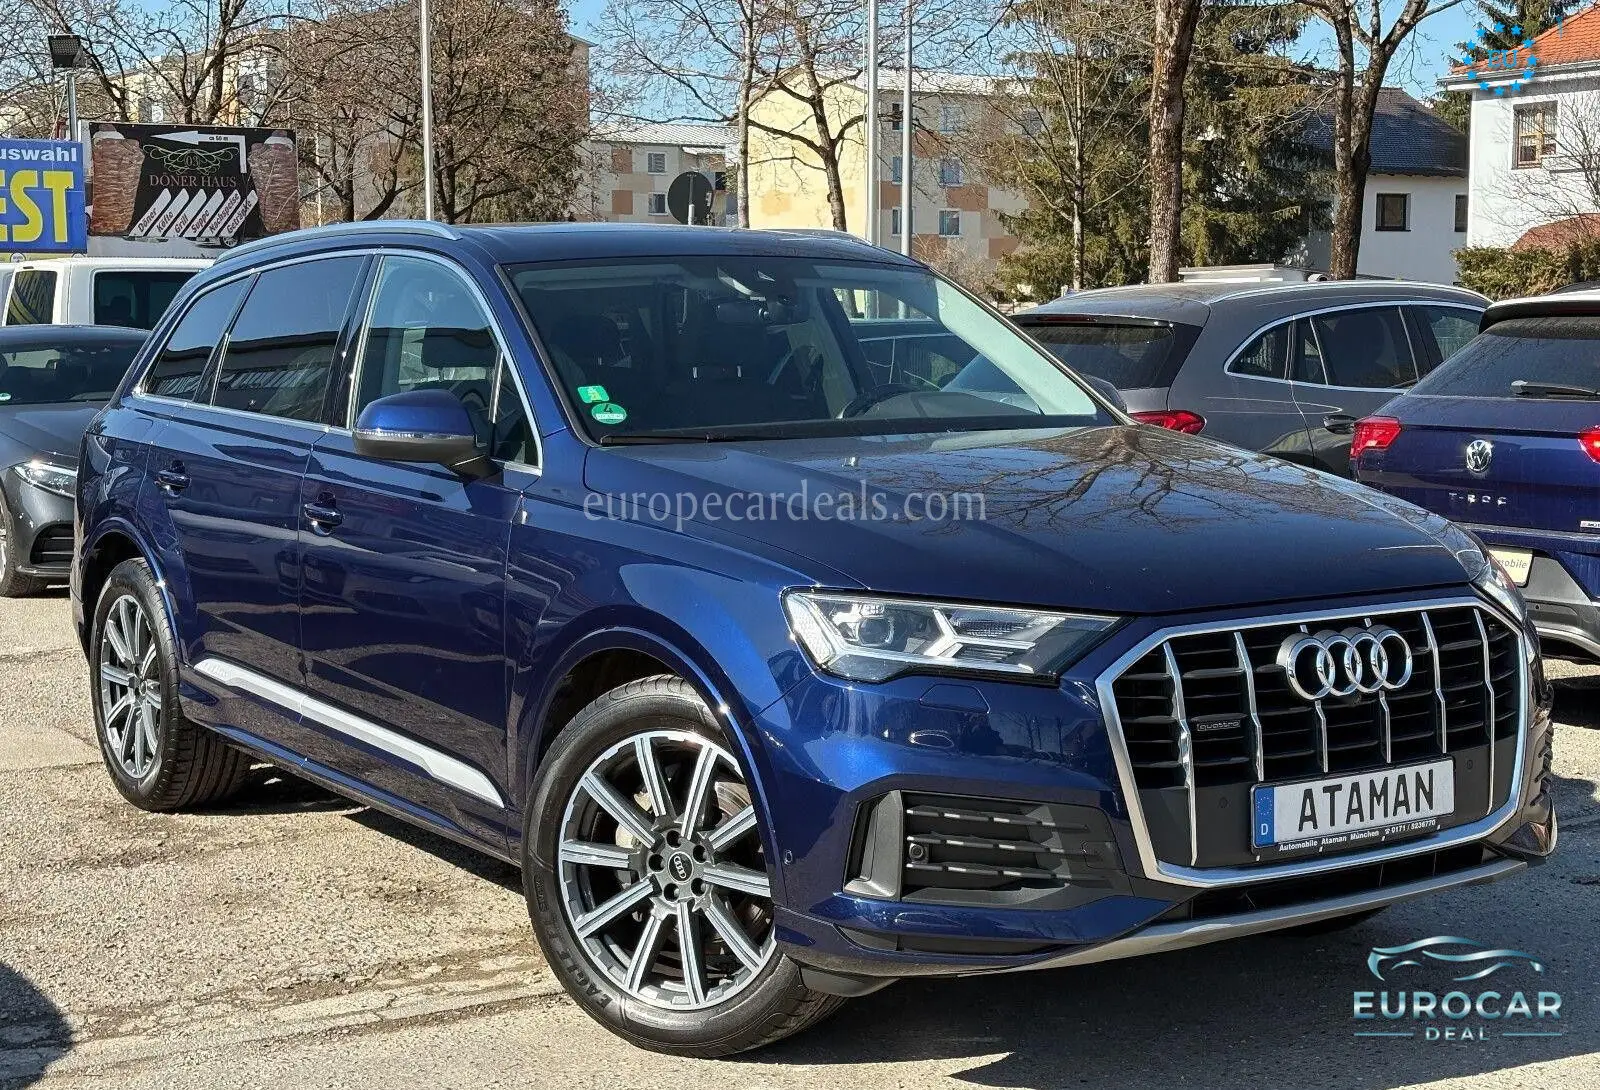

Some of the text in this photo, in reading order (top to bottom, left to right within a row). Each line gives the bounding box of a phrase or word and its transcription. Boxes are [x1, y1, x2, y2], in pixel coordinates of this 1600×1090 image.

[149, 172, 237, 187] DÖNER HAUS
[137, 207, 157, 233] Döner
[174, 213, 189, 234] Grill
[191, 209, 210, 234] Suppe
[209, 193, 240, 234] Nachspeise
[1298, 769, 1434, 832] ATAMAN
[1260, 823, 1269, 836] D
[1278, 839, 1318, 852] Automobile
[1321, 836, 1347, 846] Ataman
[1350, 829, 1380, 840] München
[1391, 825, 1406, 833] 0171
